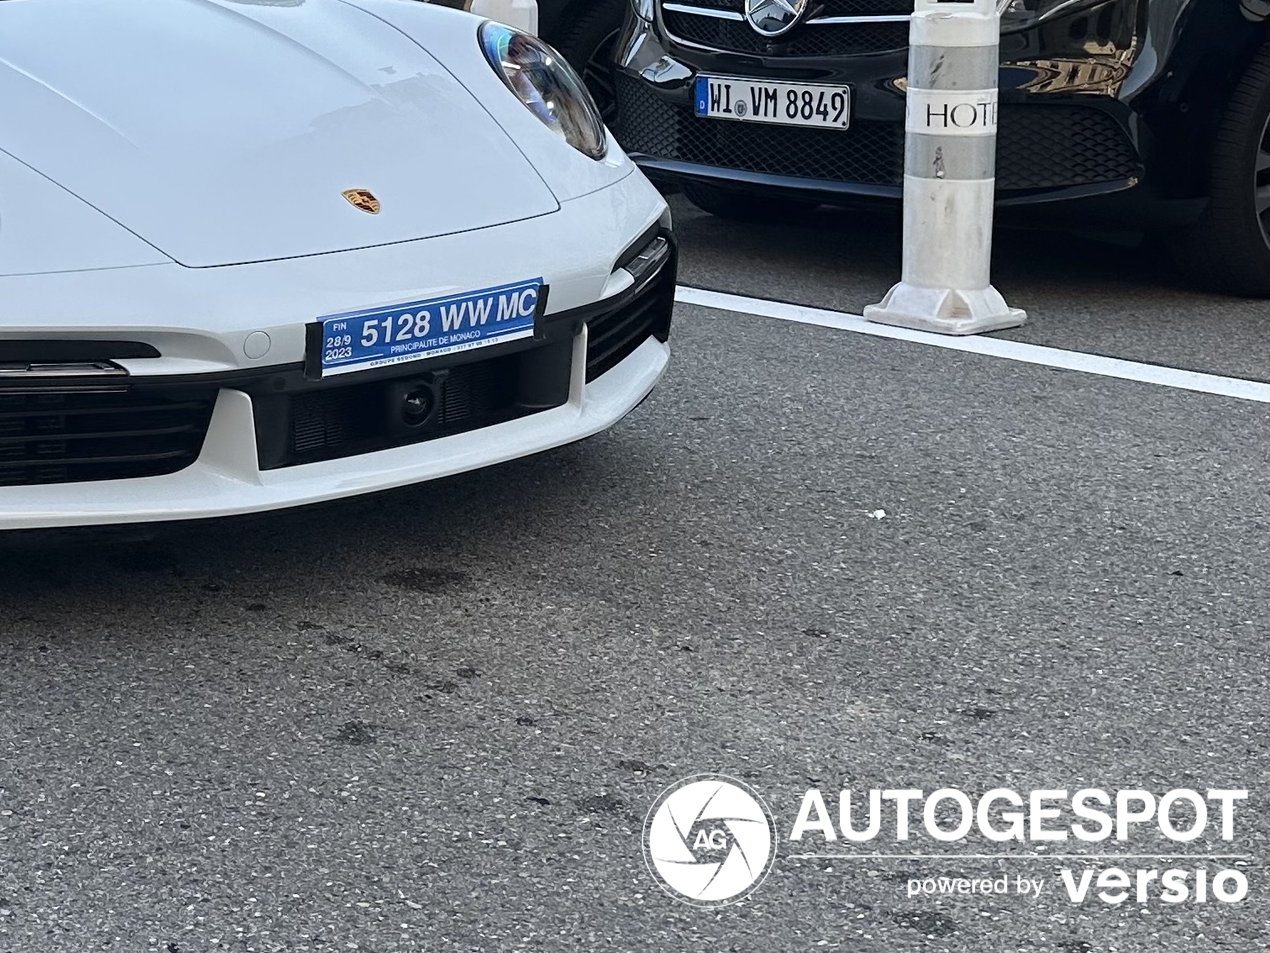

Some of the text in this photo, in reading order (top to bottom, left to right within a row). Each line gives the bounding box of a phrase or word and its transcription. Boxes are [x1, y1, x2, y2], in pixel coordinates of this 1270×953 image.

[710, 82, 846, 122] WI VM 8849
[333, 322, 347, 332] FIN
[360, 289, 536, 347] 5128 WW MC
[326, 334, 352, 348] 28/9
[390, 338, 438, 354] PRINCIPAUTE
[439, 335, 449, 345] DE
[450, 330, 481, 343] MONACO
[325, 347, 352, 361] 2023
